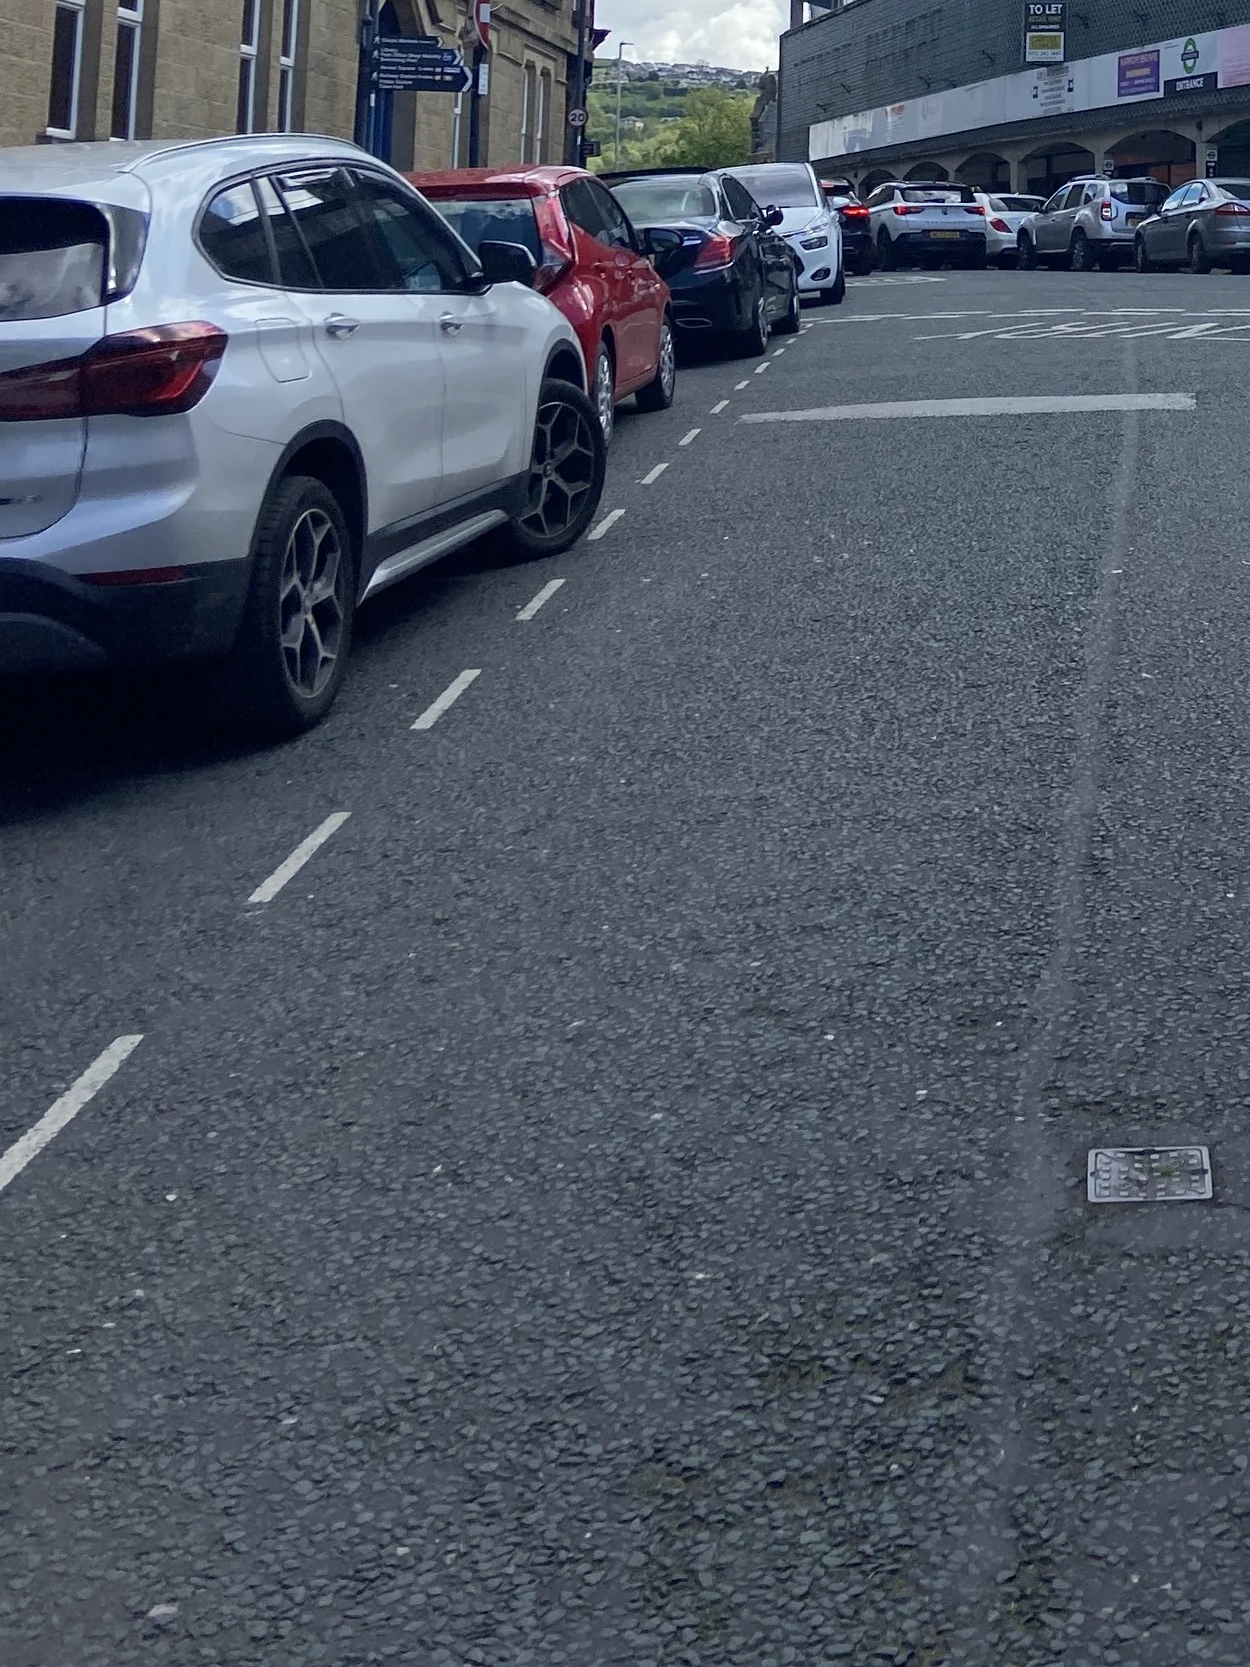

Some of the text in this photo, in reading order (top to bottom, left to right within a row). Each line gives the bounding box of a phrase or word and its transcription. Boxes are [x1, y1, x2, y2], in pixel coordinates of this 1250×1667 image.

[1029, 4, 1063, 15] TO LET
[1175, 77, 1204, 92] ENTRANCE
[571, 113, 585, 122] 20
